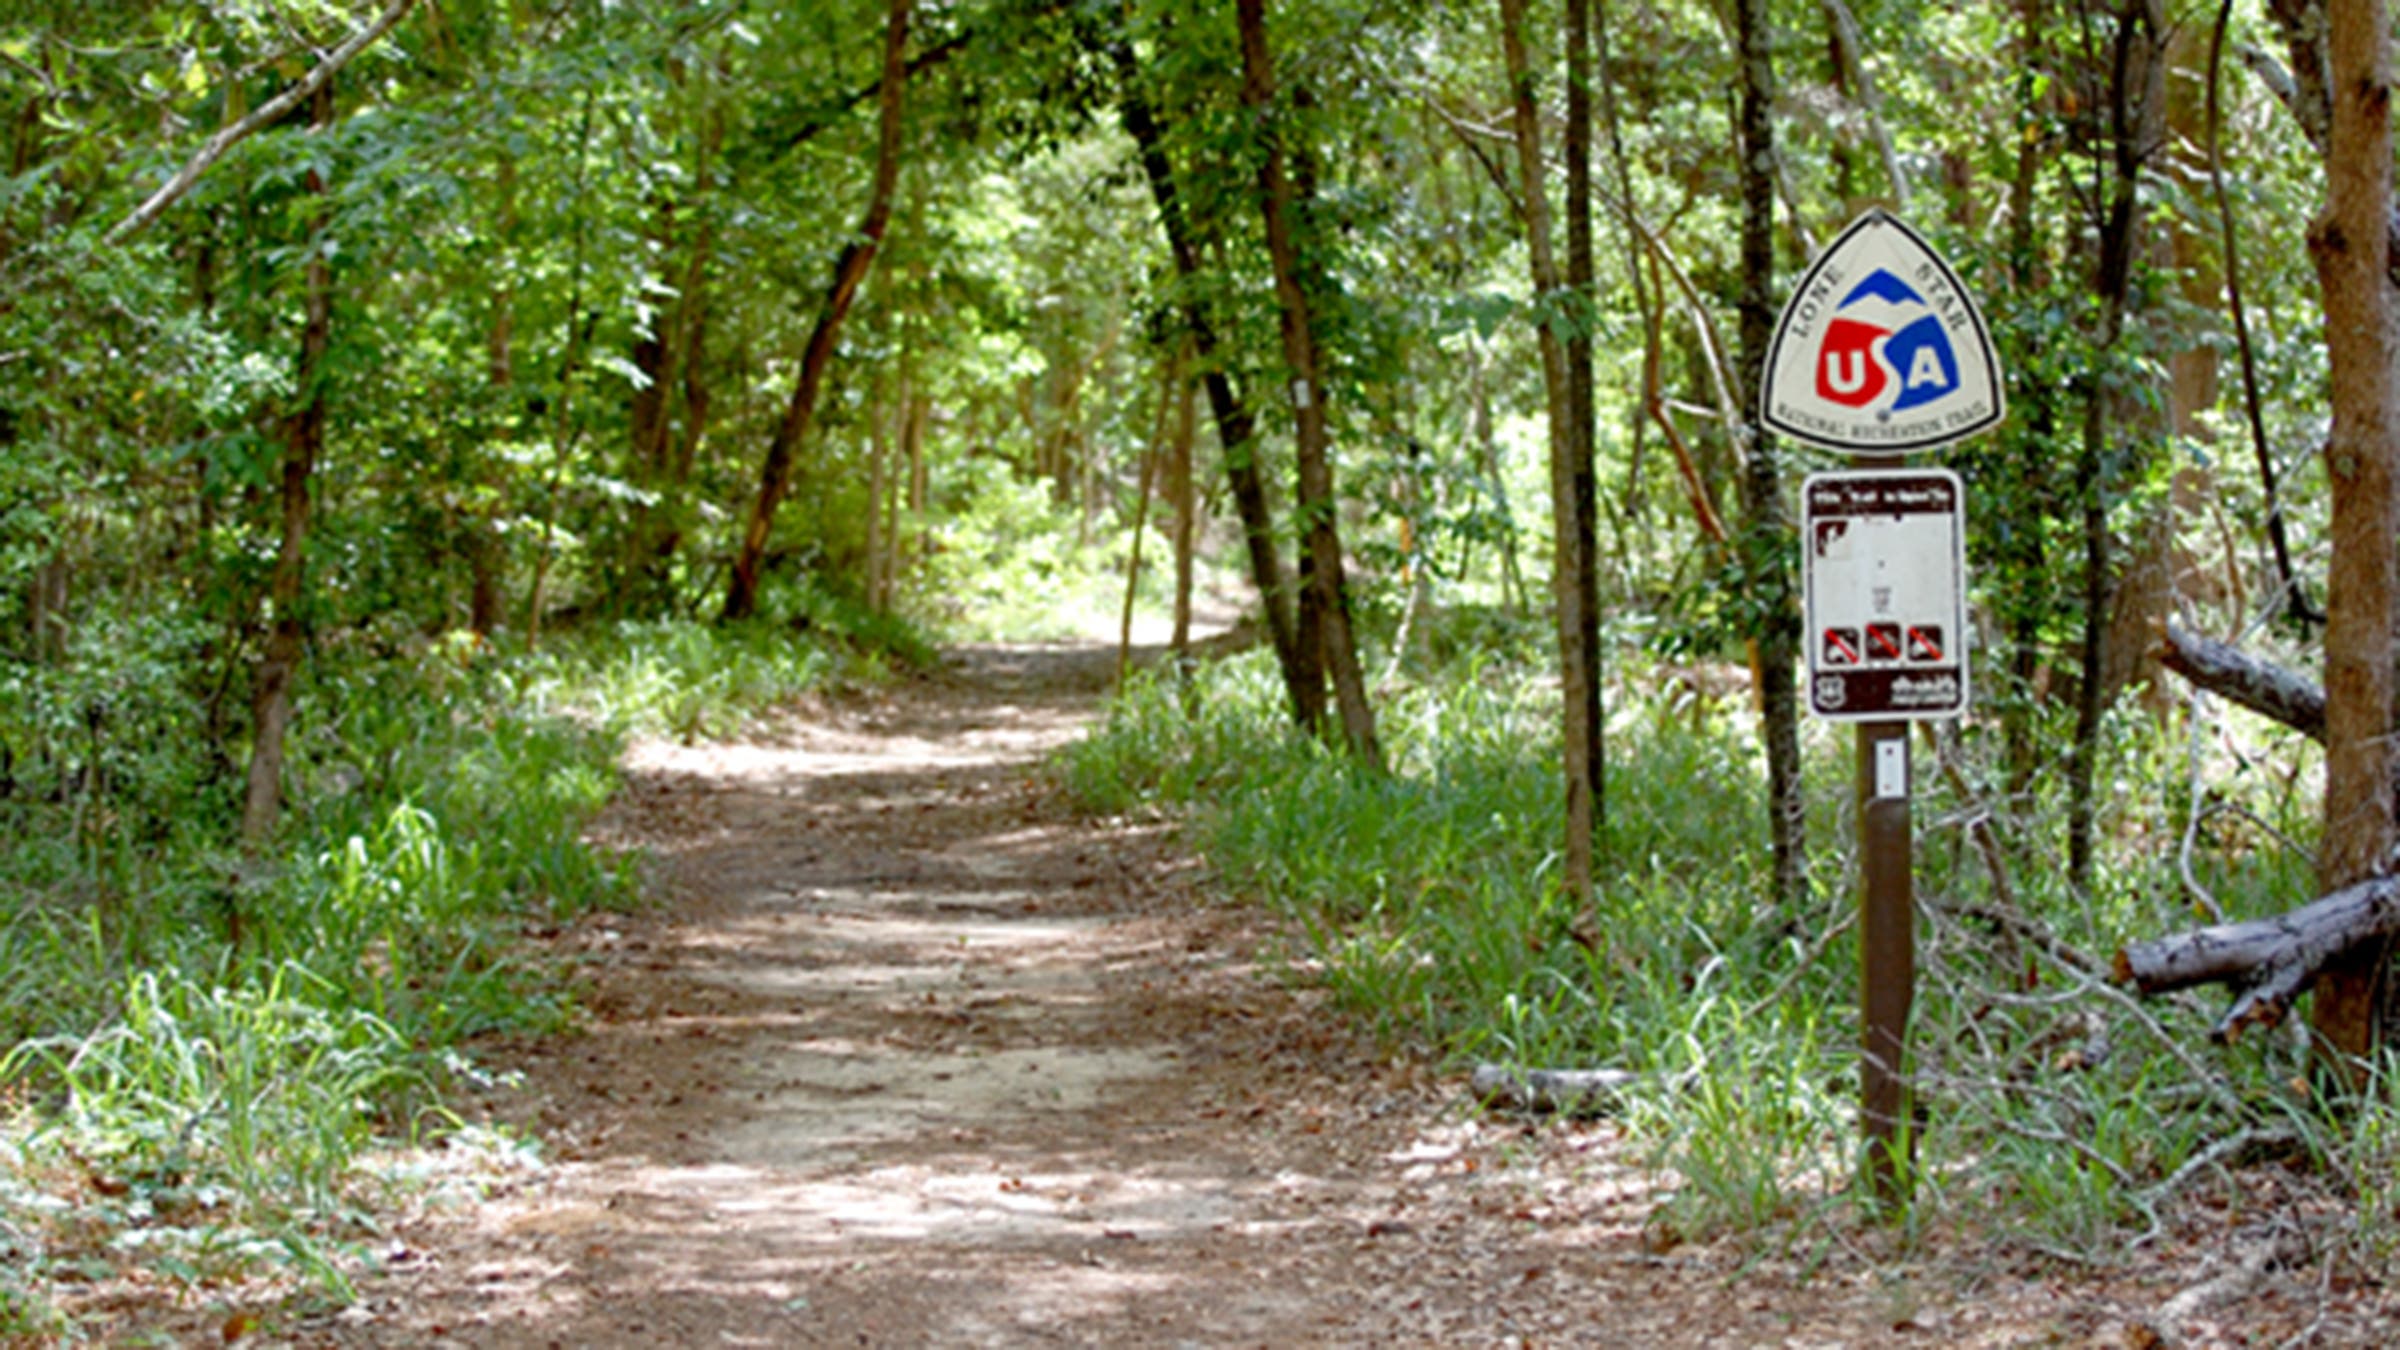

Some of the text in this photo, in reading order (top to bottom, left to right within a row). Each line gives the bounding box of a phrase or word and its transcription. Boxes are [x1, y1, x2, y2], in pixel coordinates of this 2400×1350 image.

[1791, 262, 1968, 339] LONE STAR
[1826, 334, 1949, 408] USA
